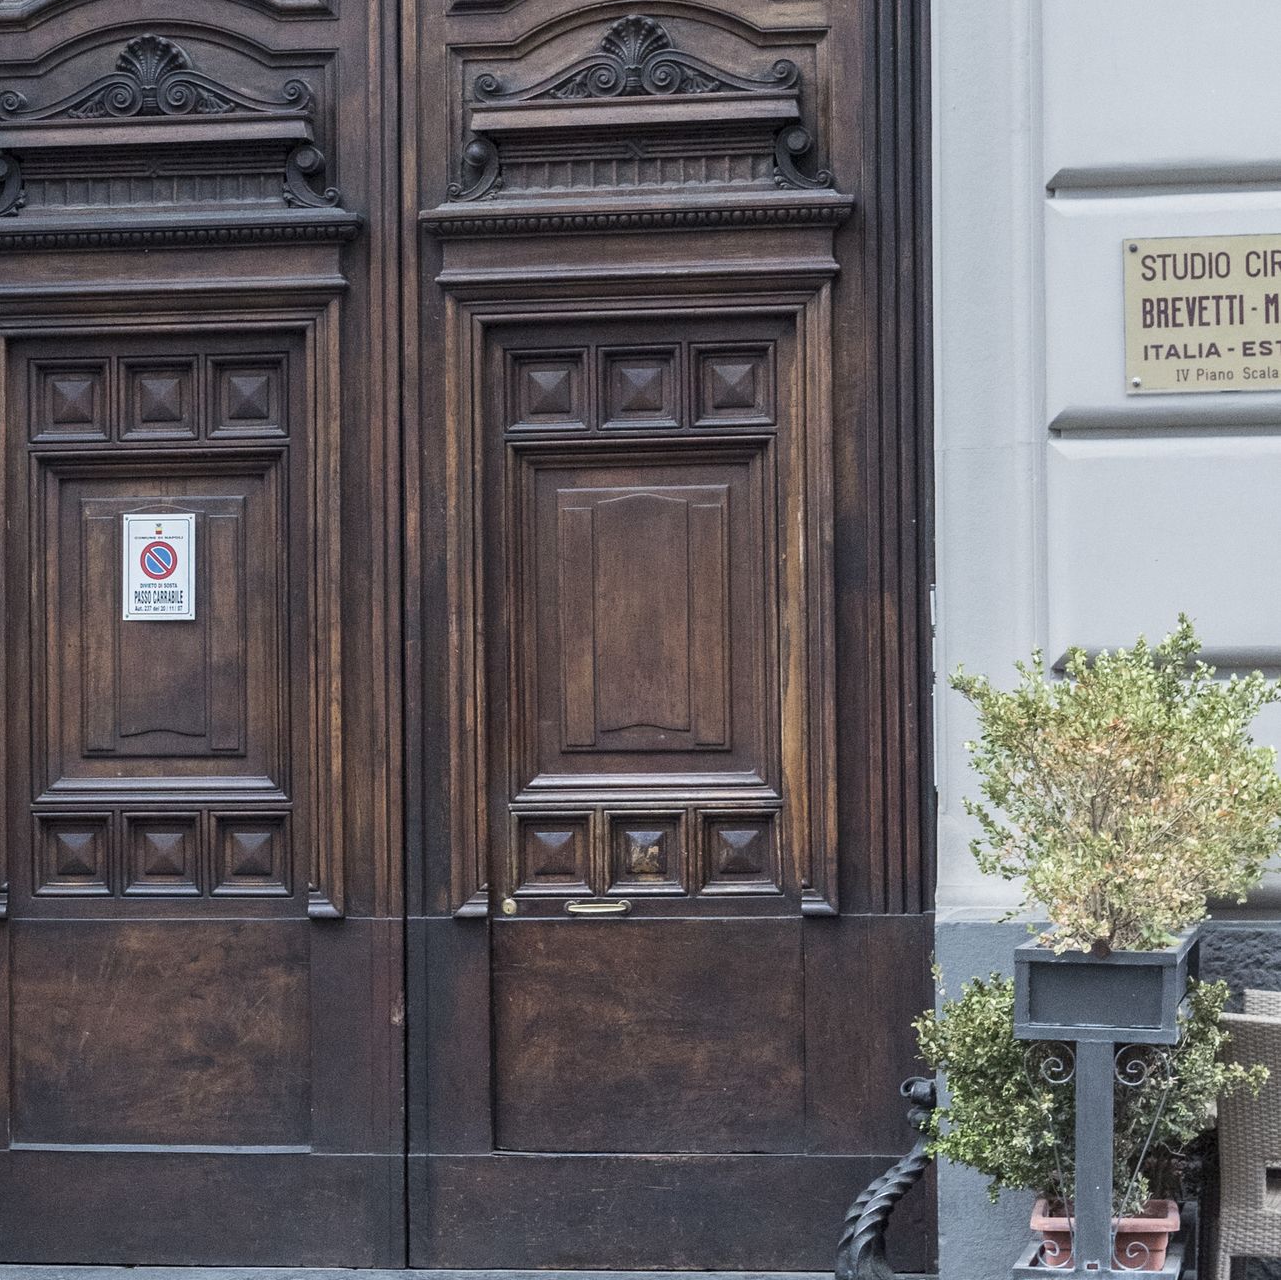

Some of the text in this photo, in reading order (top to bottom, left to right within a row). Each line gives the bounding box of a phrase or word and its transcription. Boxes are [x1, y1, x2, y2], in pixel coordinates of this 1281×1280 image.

[1141, 251, 1231, 281] STUDIO
[1142, 294, 1244, 329] BREVETTI
[1143, 342, 1222, 361] ITALIA
[1176, 366, 1279, 382] IV Piano Scala
[134, 590, 184, 604] PASSO CARRABILE
